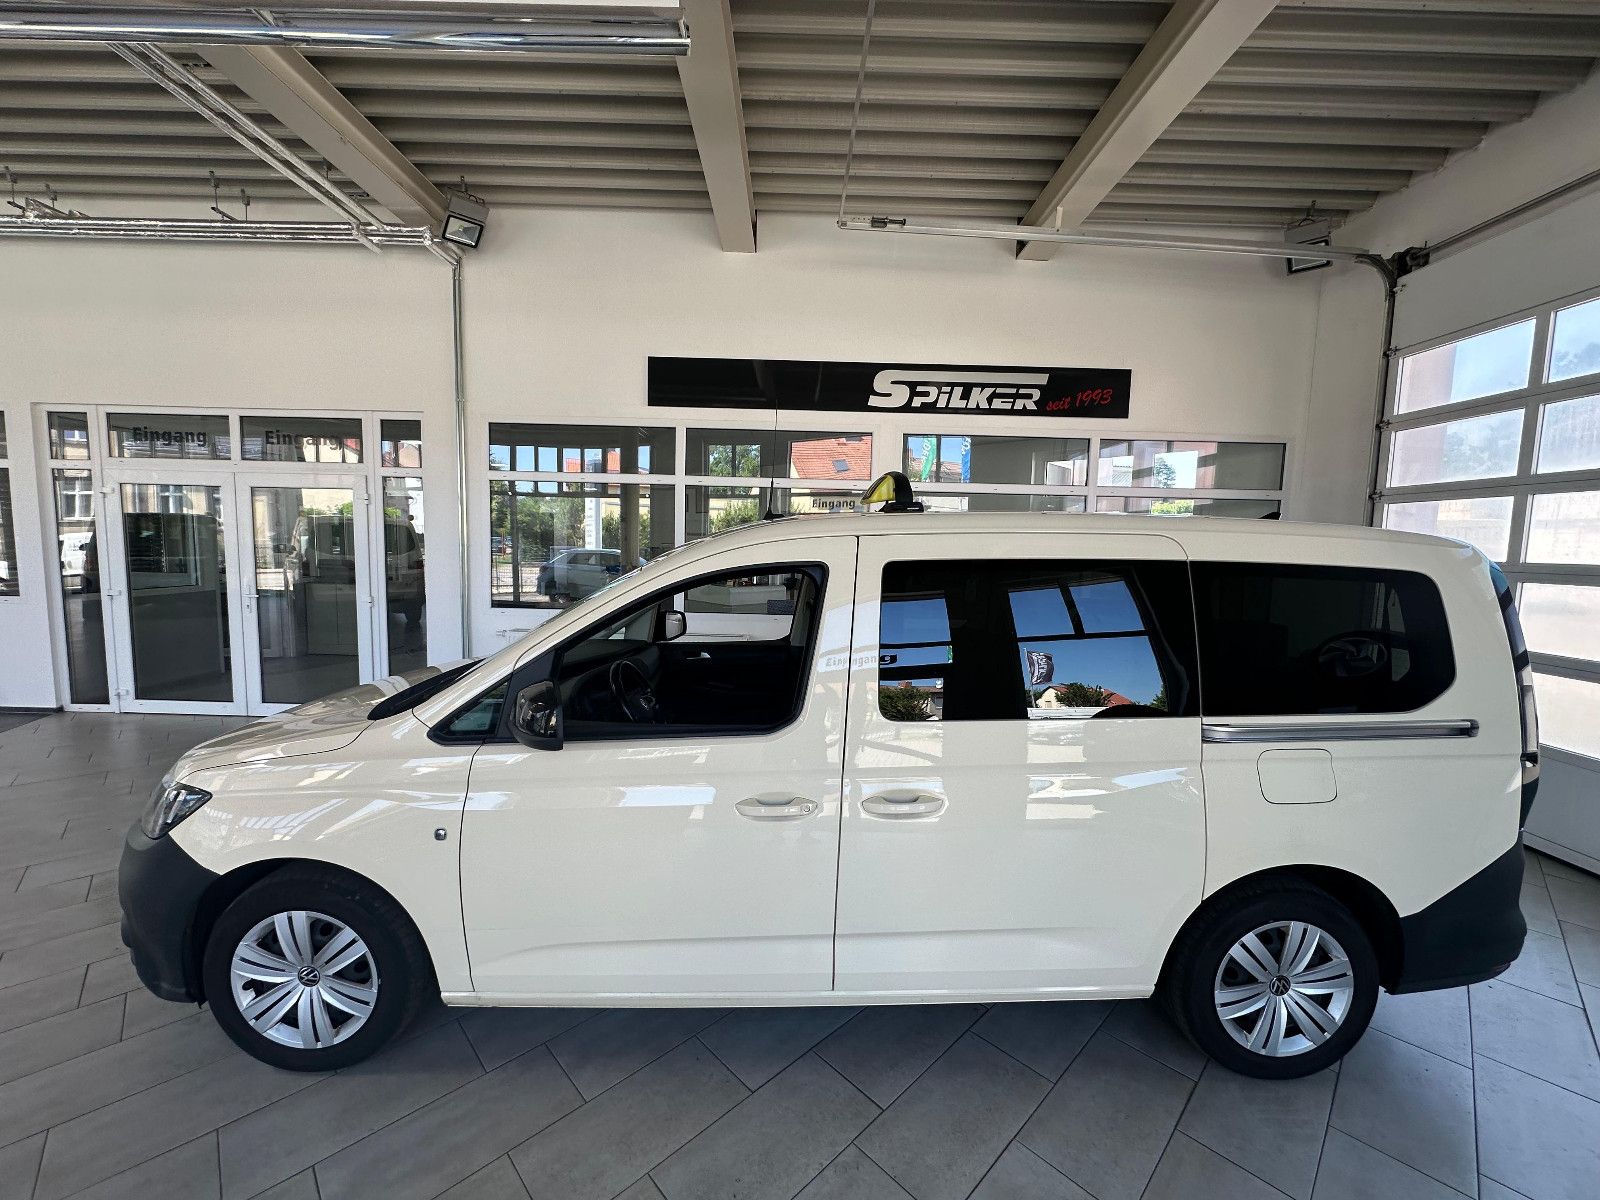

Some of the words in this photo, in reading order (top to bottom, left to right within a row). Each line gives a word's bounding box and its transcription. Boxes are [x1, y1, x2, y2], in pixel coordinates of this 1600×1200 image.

[1046, 398, 1070, 411] seit
[1074, 389, 1113, 407] 1993
[132, 426, 207, 447] Eingang
[265, 430, 343, 450] Eingang
[812, 498, 856, 510] Eingang
